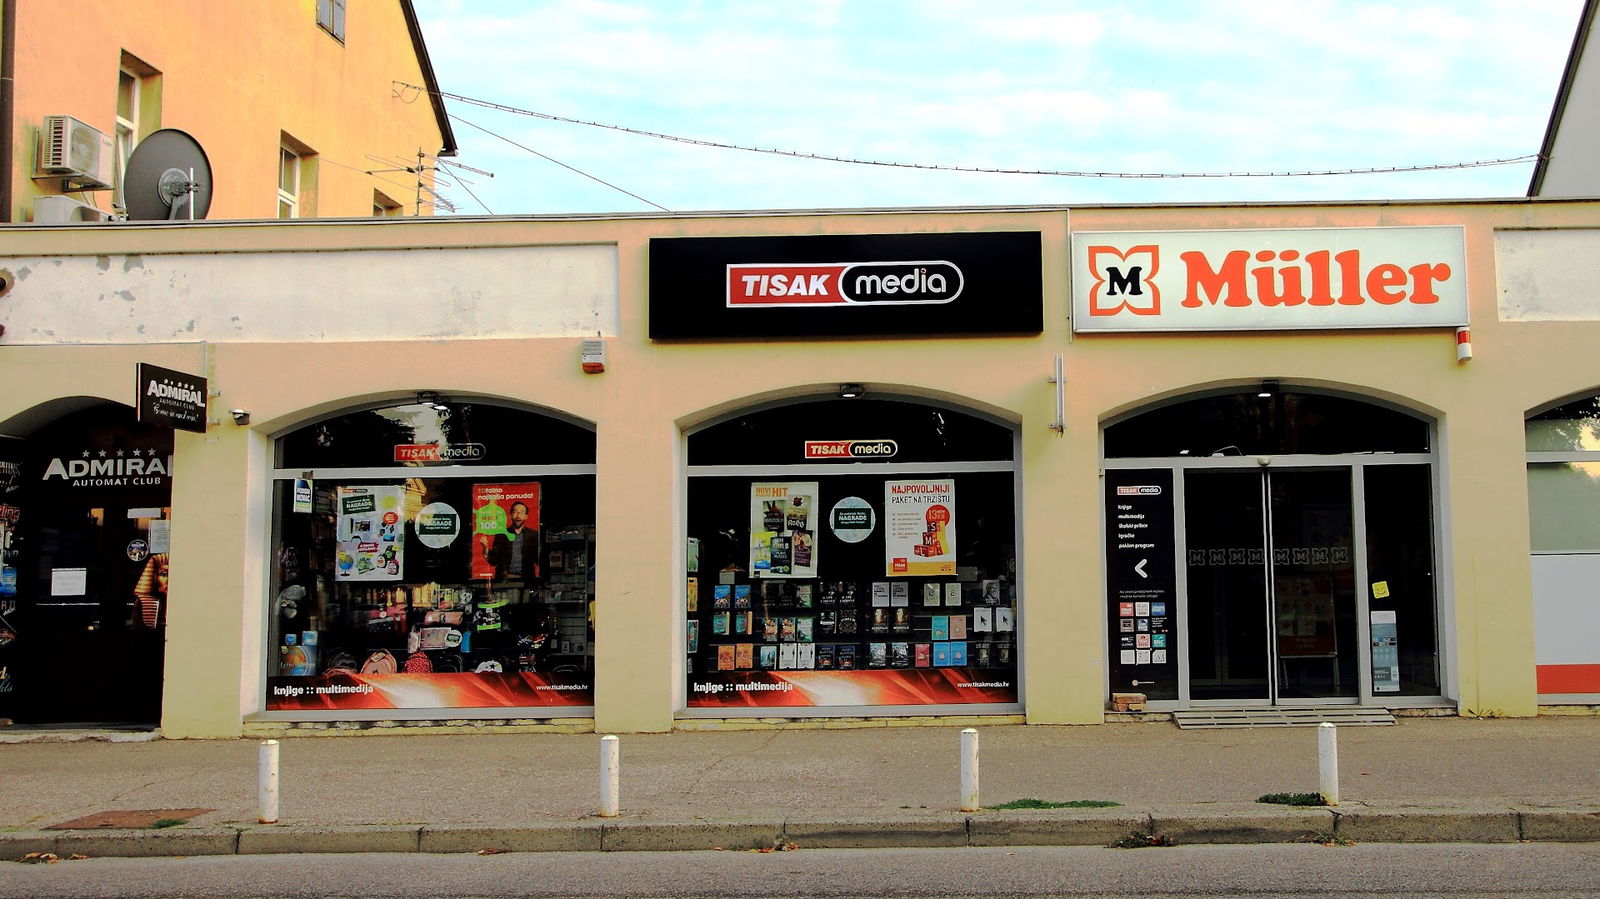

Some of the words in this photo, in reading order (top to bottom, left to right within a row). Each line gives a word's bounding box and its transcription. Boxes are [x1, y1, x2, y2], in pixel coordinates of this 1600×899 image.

[741, 274, 830, 297] TISAK
[856, 268, 947, 294] media
[1180, 249, 1450, 308] Müller
[147, 379, 206, 408] ADMIRAL
[444, 446, 480, 456] media
[811, 445, 845, 454] TISAK
[855, 443, 891, 454] media
[73, 478, 128, 487] AUTOMAT
[133, 477, 161, 486] CLUB
[772, 487, 789, 497] HIT
[891, 484, 950, 494] NAJPOVOLJNIJI
[891, 496, 912, 504] PAKET
[273, 686, 304, 697] knjige
[315, 684, 374, 695] multimedija
[693, 682, 724, 694] knjige
[735, 681, 793, 693] multimedija
